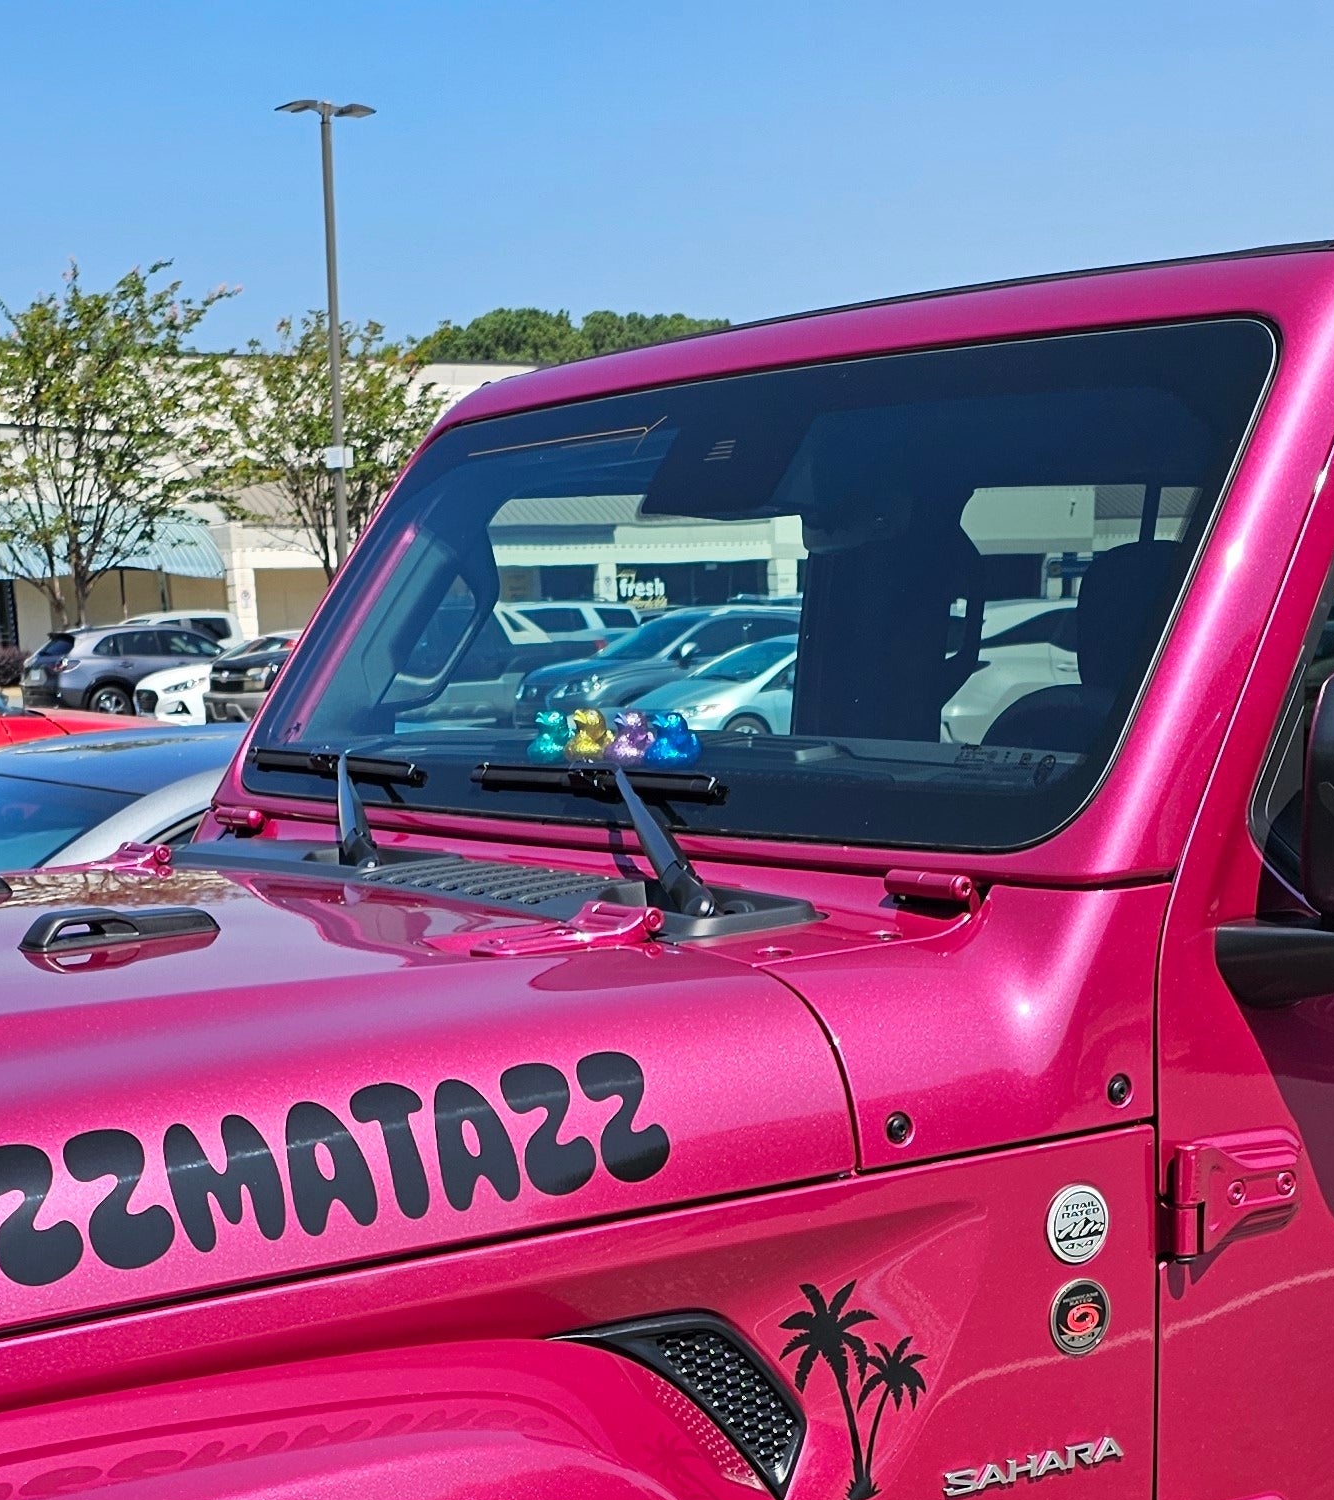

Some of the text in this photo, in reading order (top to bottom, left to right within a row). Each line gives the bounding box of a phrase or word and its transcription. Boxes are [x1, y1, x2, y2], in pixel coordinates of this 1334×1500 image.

[619, 577, 665, 598] fresh
[1062, 1207, 1100, 1220] RATED
[1064, 1201, 1098, 1212] TRAIL
[943, 1436, 1124, 1497] SAHARA
